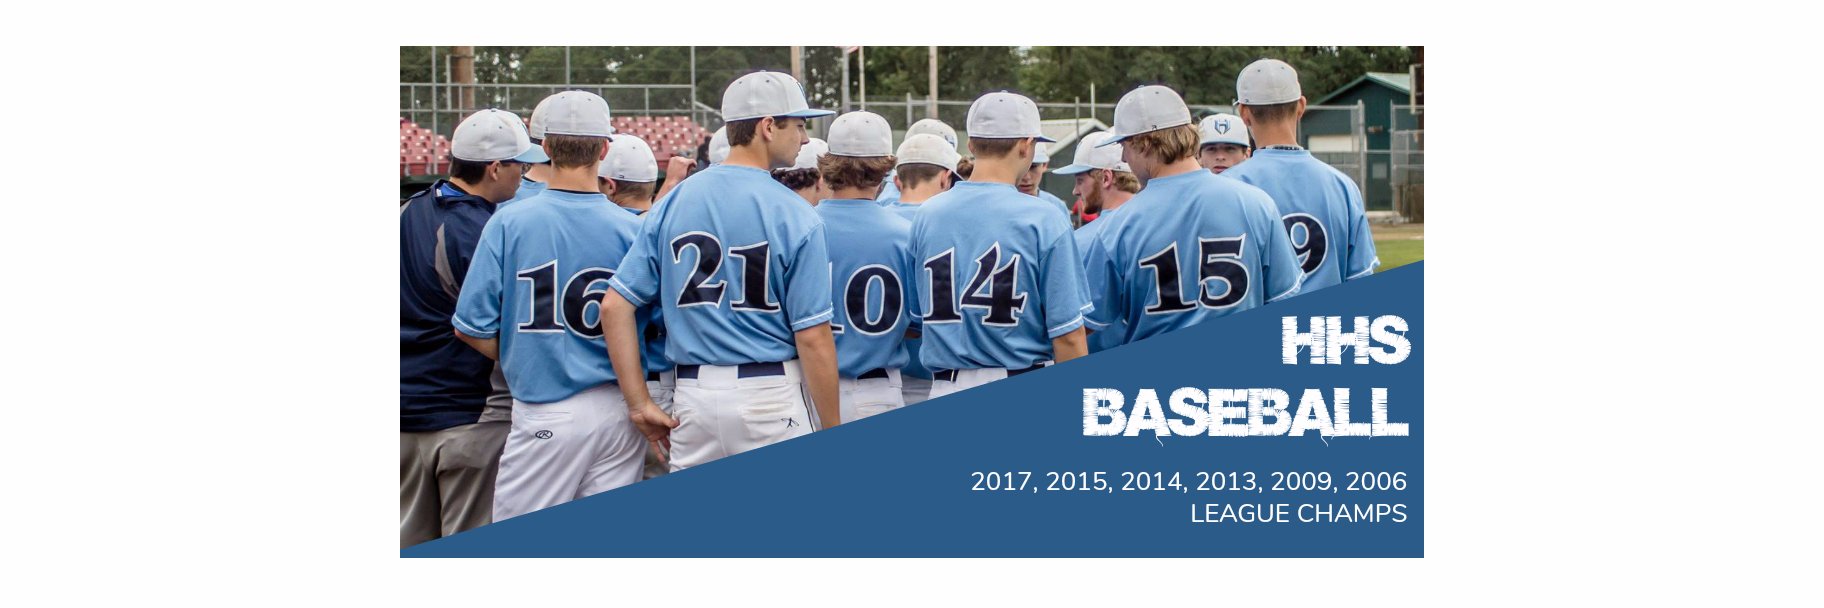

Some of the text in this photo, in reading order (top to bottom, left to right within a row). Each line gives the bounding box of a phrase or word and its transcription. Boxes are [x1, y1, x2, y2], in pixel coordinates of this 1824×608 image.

[516, 259, 616, 339] 16
[670, 231, 781, 313] 21
[829, 261, 904, 336] 0
[923, 241, 1028, 327] 14
[1138, 233, 1250, 315] 15
